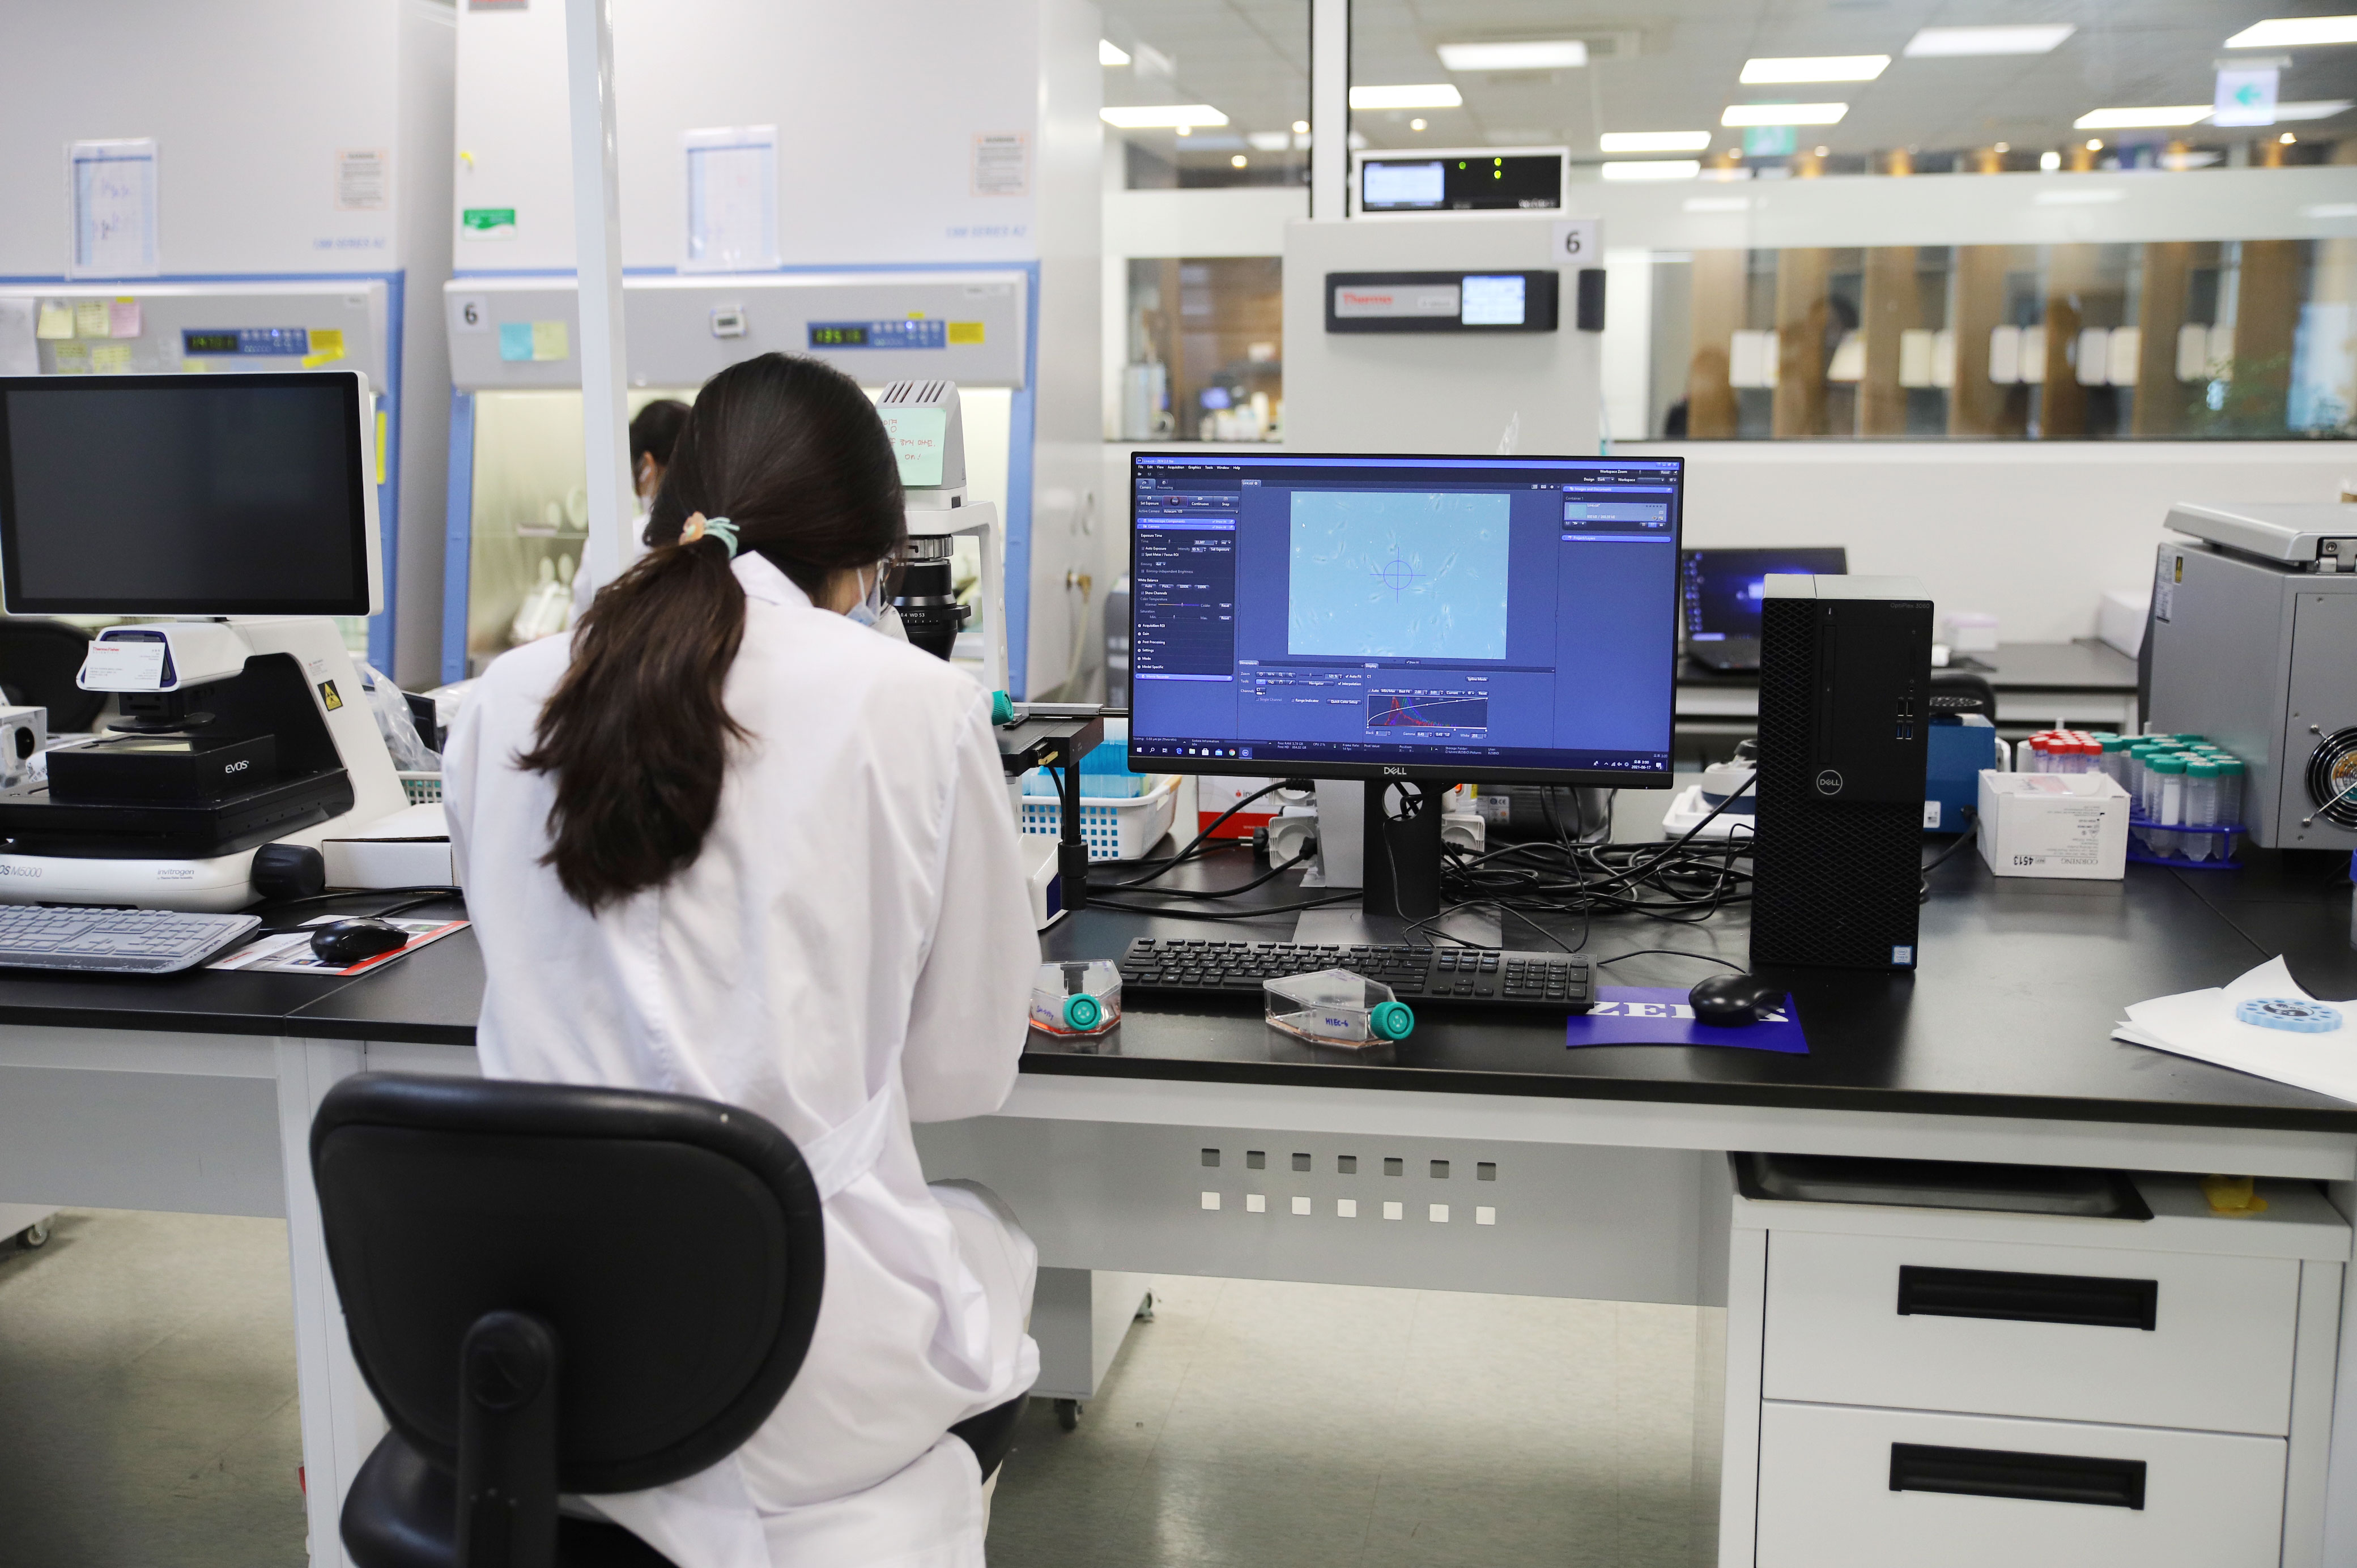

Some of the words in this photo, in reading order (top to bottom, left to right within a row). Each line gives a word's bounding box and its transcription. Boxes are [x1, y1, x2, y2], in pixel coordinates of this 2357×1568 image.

[1566, 231, 1580, 253] 6
[464, 301, 478, 326] 6
[225, 760, 248, 773] EVOS
[2014, 856, 2033, 865] 4513
[11, 866, 42, 877] M5000
